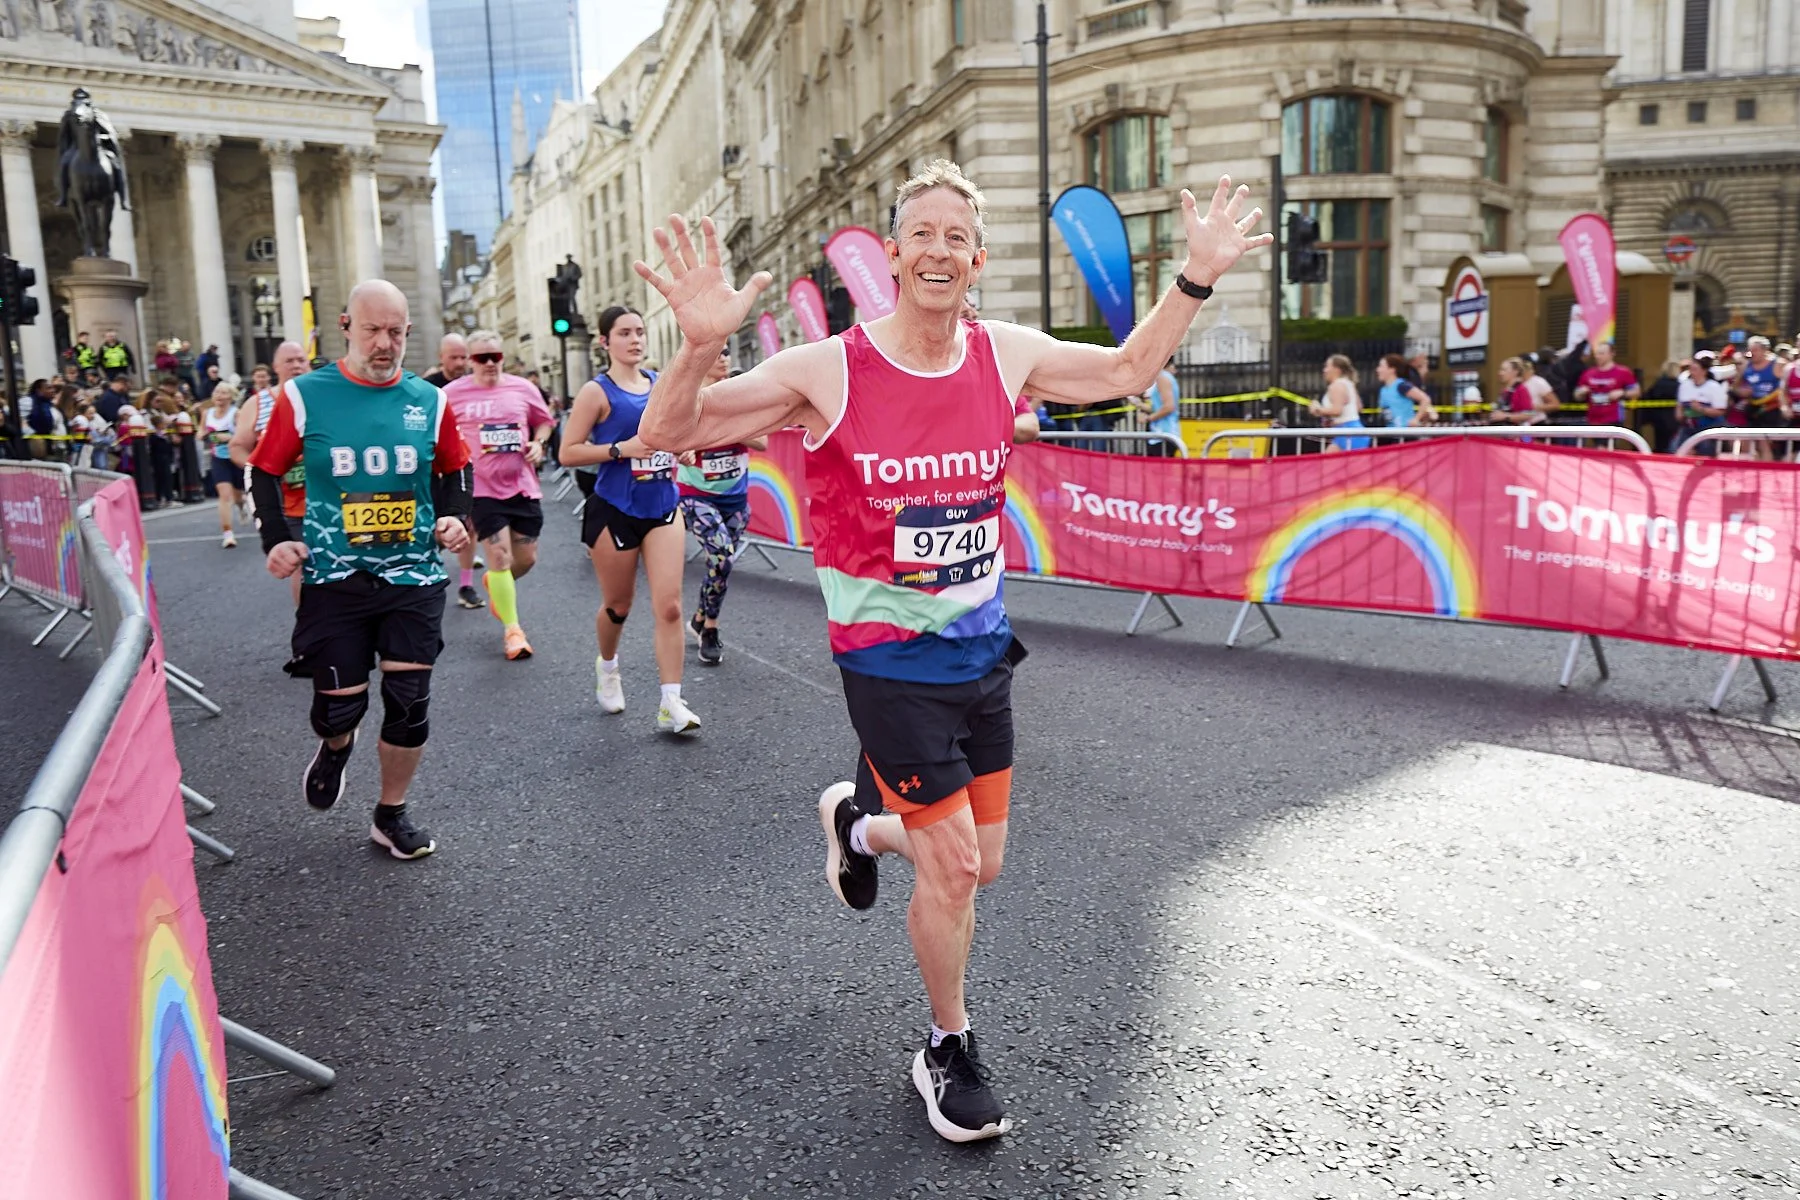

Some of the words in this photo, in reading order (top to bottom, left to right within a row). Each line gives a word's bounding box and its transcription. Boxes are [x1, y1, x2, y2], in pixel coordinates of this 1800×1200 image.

[330, 445, 418, 477] BOB
[709, 456, 738, 471] 9156
[866, 492, 930, 513] Together,
[934, 489, 952, 504] for
[945, 508, 968, 520] GUY
[1061, 481, 1237, 536] Tommy's
[348, 506, 413, 527] 12626
[1505, 485, 1776, 568] Tommy's
[913, 525, 986, 557] 9740
[1139, 537, 1160, 548] and
[1162, 538, 1191, 553] baby
[1192, 541, 1233, 556] charity
[1503, 545, 1532, 561] The
[1536, 552, 1621, 575] pregnancy
[1657, 567, 1706, 591] baby
